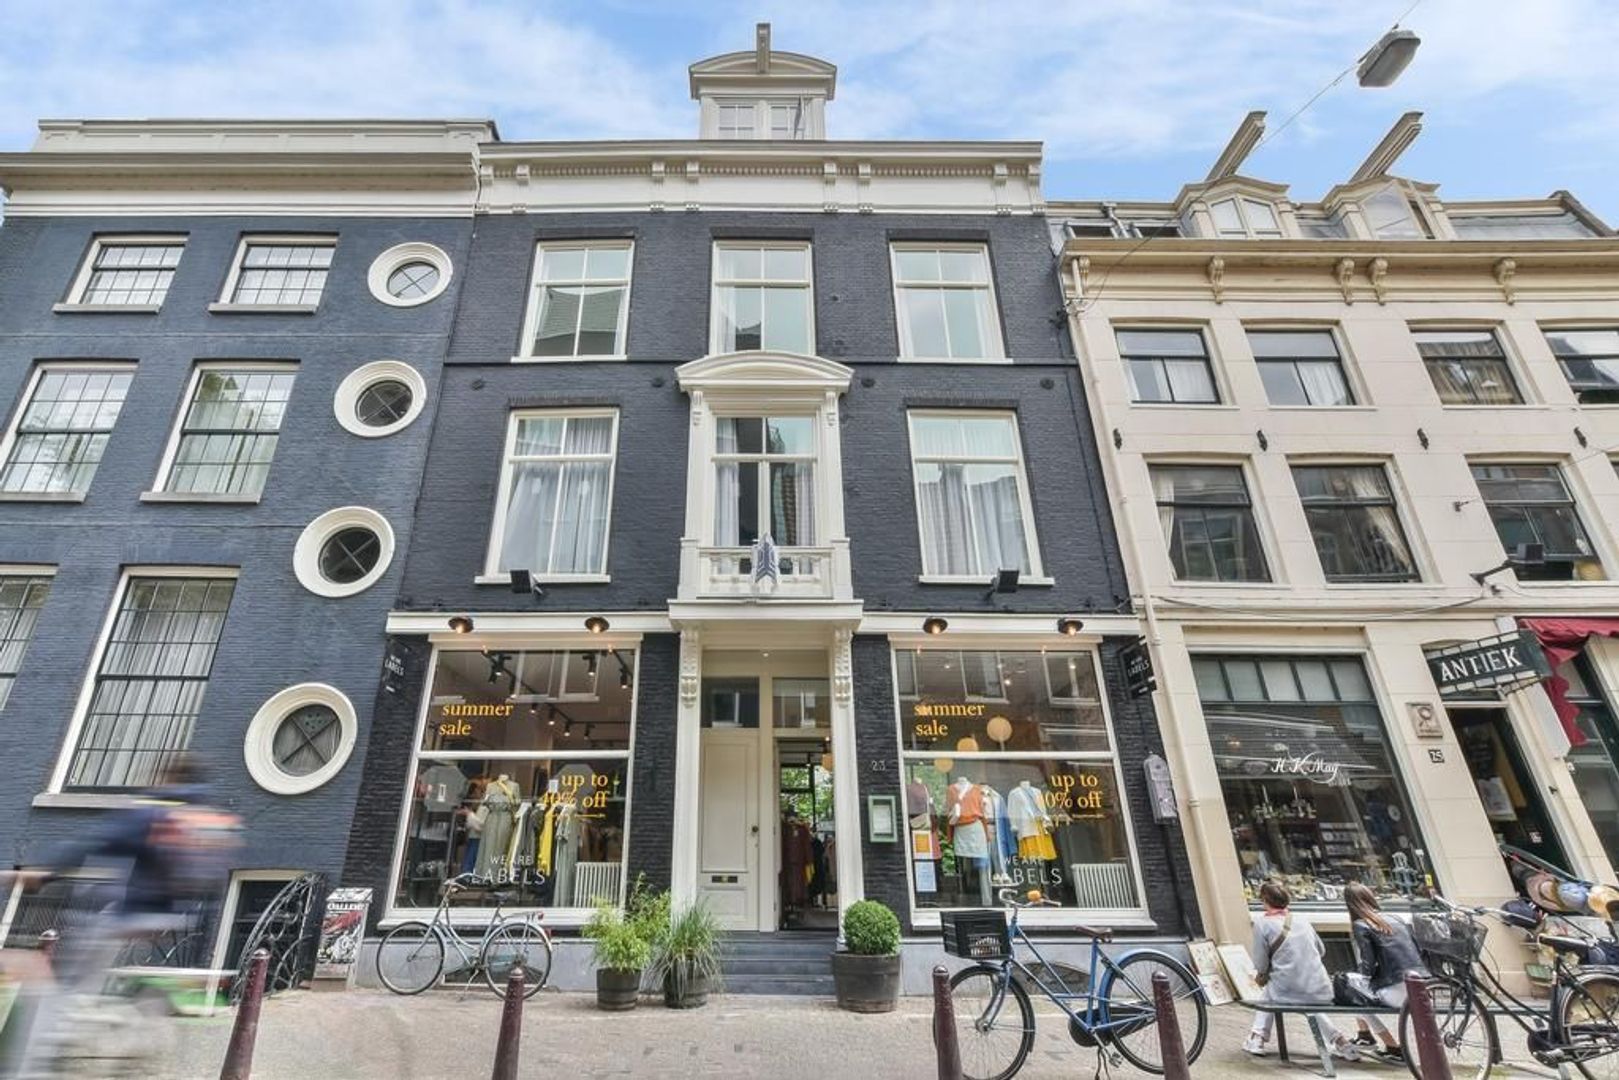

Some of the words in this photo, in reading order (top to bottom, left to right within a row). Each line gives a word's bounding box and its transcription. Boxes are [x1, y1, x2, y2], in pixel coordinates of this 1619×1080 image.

[1441, 646, 1522, 681] ANTIEK
[442, 704, 514, 716] summer
[914, 704, 985, 716] summer
[439, 719, 472, 736] sale
[915, 719, 948, 736] sale
[872, 761, 886, 771] 23
[561, 775, 585, 791] up
[591, 774, 609, 787] to
[1051, 775, 1075, 792] up
[1080, 774, 1098, 787] to
[582, 791, 611, 808] off
[1077, 791, 1103, 808] off
[471, 867, 546, 885] LABELS
